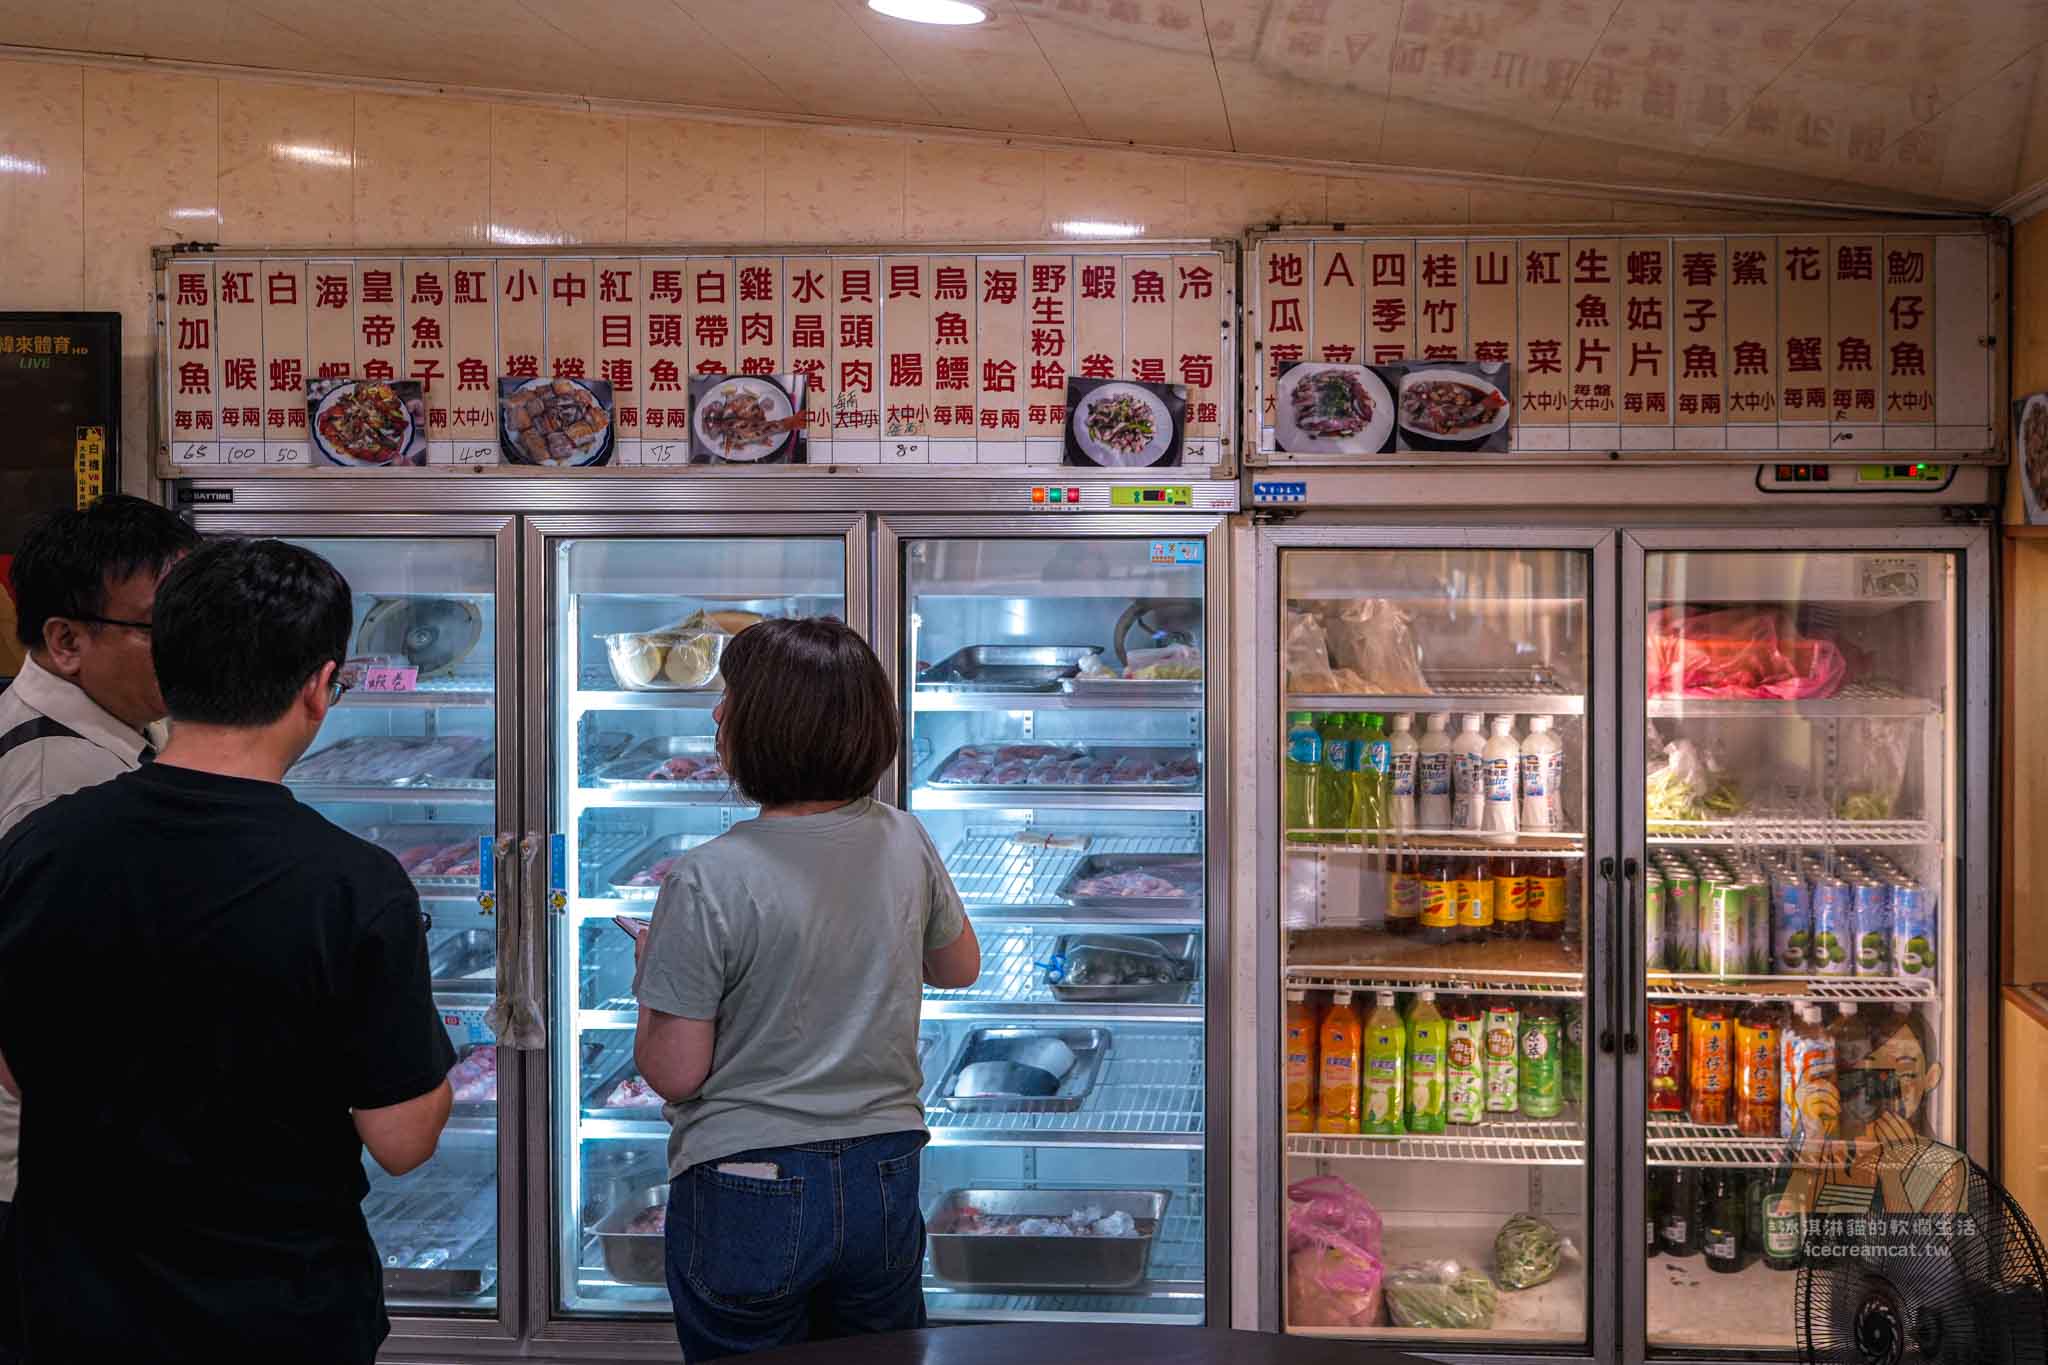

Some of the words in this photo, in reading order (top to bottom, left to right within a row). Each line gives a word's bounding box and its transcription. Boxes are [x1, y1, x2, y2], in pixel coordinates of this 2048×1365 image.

[1526, 250, 1561, 375] 紅菜
[1574, 247, 1610, 375] 生魚片
[1626, 250, 1663, 377] 蝦姑片
[1682, 251, 1718, 378] 春子魚
[1731, 250, 1768, 376] 鯊魚
[1785, 246, 1822, 373] 花蟹
[176, 273, 211, 394] 馬加魚
[222, 271, 257, 391] 紅喉
[268, 271, 302, 392] 白蝦
[410, 271, 444, 392] 烏魚子
[454, 270, 490, 391] 魟魚
[649, 270, 683, 391] 馬頭魚
[840, 269, 873, 393] 貝頭肉
[888, 265, 923, 387] 貝腸
[983, 269, 1017, 393] 海蛤
[1030, 264, 1066, 391] 野生粉蛤
[1178, 266, 1213, 389] 冷筍
[1523, 391, 1567, 411] 大中小
[1570, 397, 1614, 411] 大中小
[1624, 392, 1666, 412] 每兩
[1679, 393, 1721, 415] 每兩
[1731, 391, 1776, 412] 大中小
[1784, 388, 1826, 410] 每兩
[1833, 389, 1875, 410] 每兩
[1888, 390, 1934, 411] 大中小
[175, 410, 213, 430] 每兩
[222, 407, 260, 428] 每兩
[267, 407, 306, 428] 每兩
[452, 407, 494, 426] 大中小
[646, 408, 685, 428] 每兩
[887, 403, 929, 423] 大中小
[934, 405, 973, 425] 每兩
[980, 408, 1020, 429] 每兩
[277, 448, 298, 461] 50
[459, 448, 491, 464] 400
